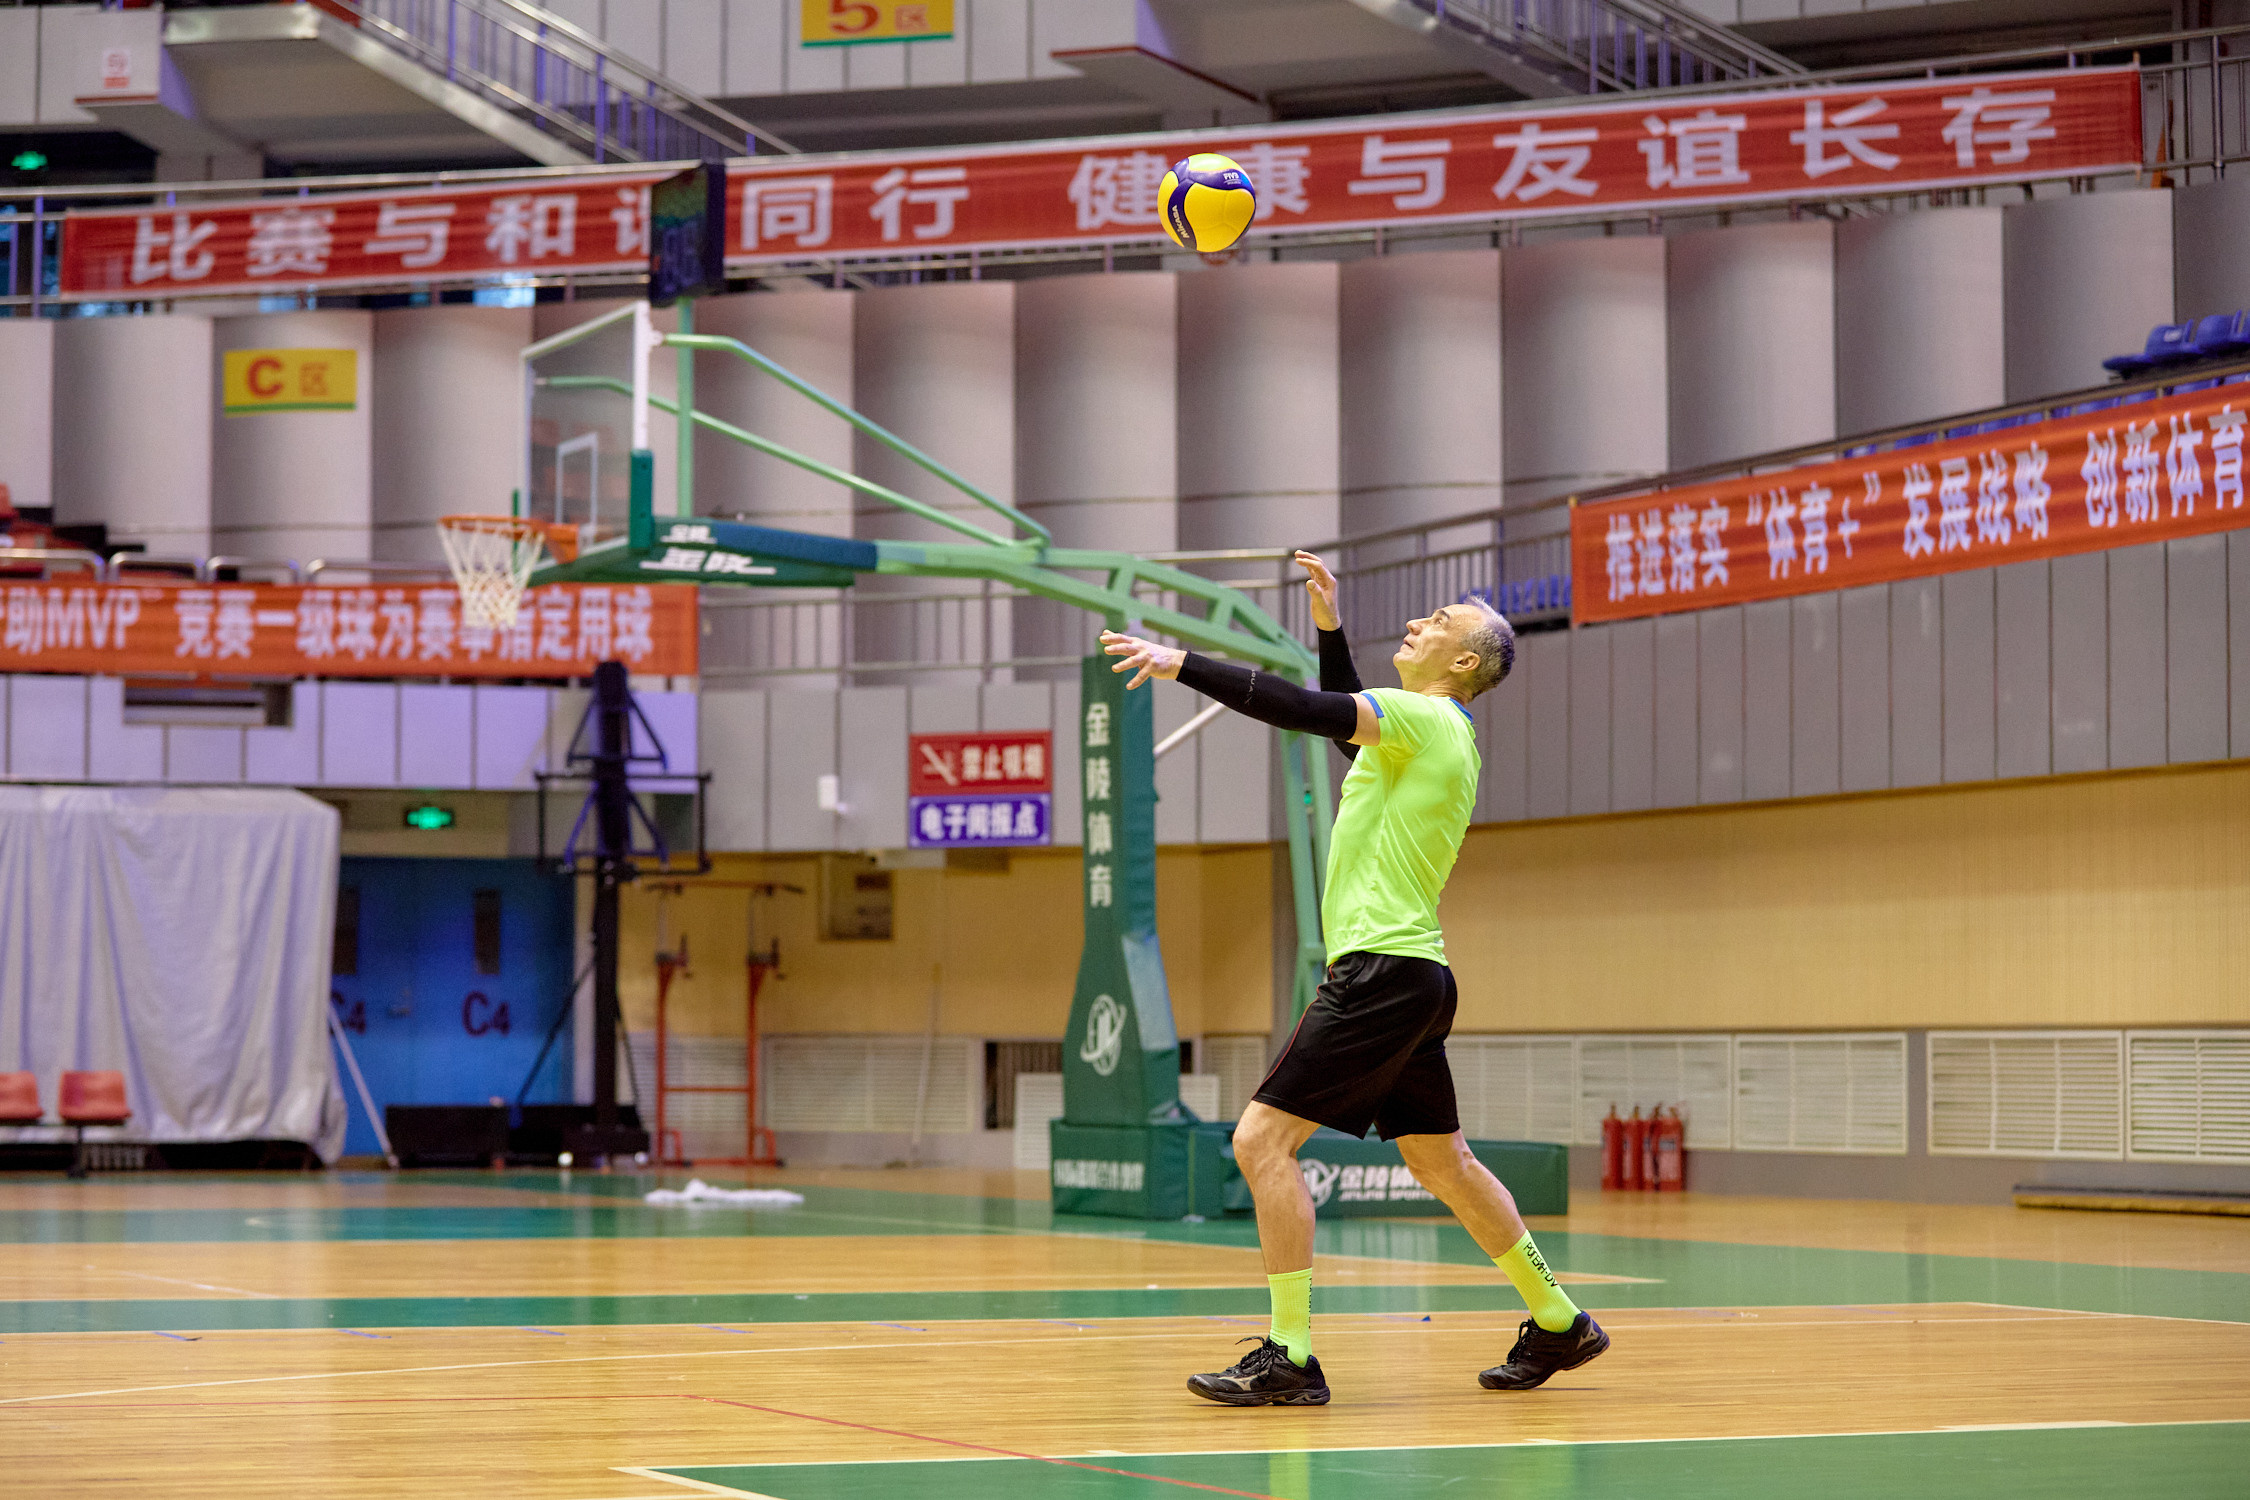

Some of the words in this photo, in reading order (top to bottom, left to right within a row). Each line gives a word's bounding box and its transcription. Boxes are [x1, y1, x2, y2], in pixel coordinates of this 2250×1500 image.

[1067, 86, 2058, 231] 健康与友谊长存
[2080, 403, 2249, 529] 创新体育
[0, 586, 141, 655] 助MVP
[1086, 702, 1113, 908] 金陵体育
[462, 989, 510, 1038] C4
[1339, 1164, 1424, 1190] 金陵体
